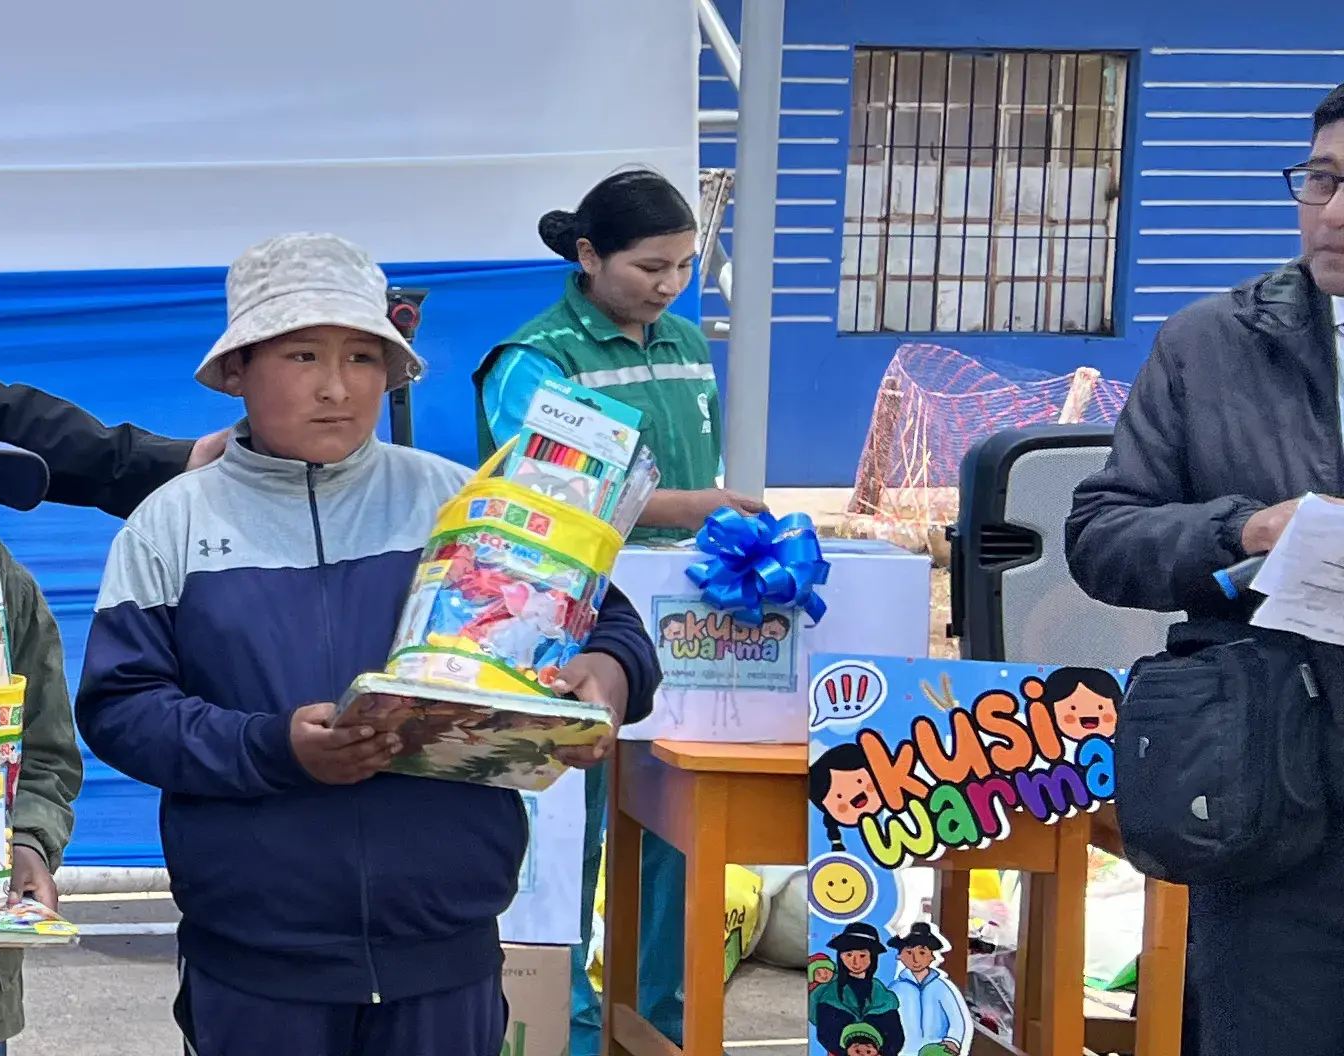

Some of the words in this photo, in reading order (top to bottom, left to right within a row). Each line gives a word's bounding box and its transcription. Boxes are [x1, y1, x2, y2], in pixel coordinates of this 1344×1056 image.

[540, 402, 586, 427] oval
[671, 637, 779, 662] warma
[856, 676, 1065, 812] kusi
[858, 734, 1116, 869] warma
